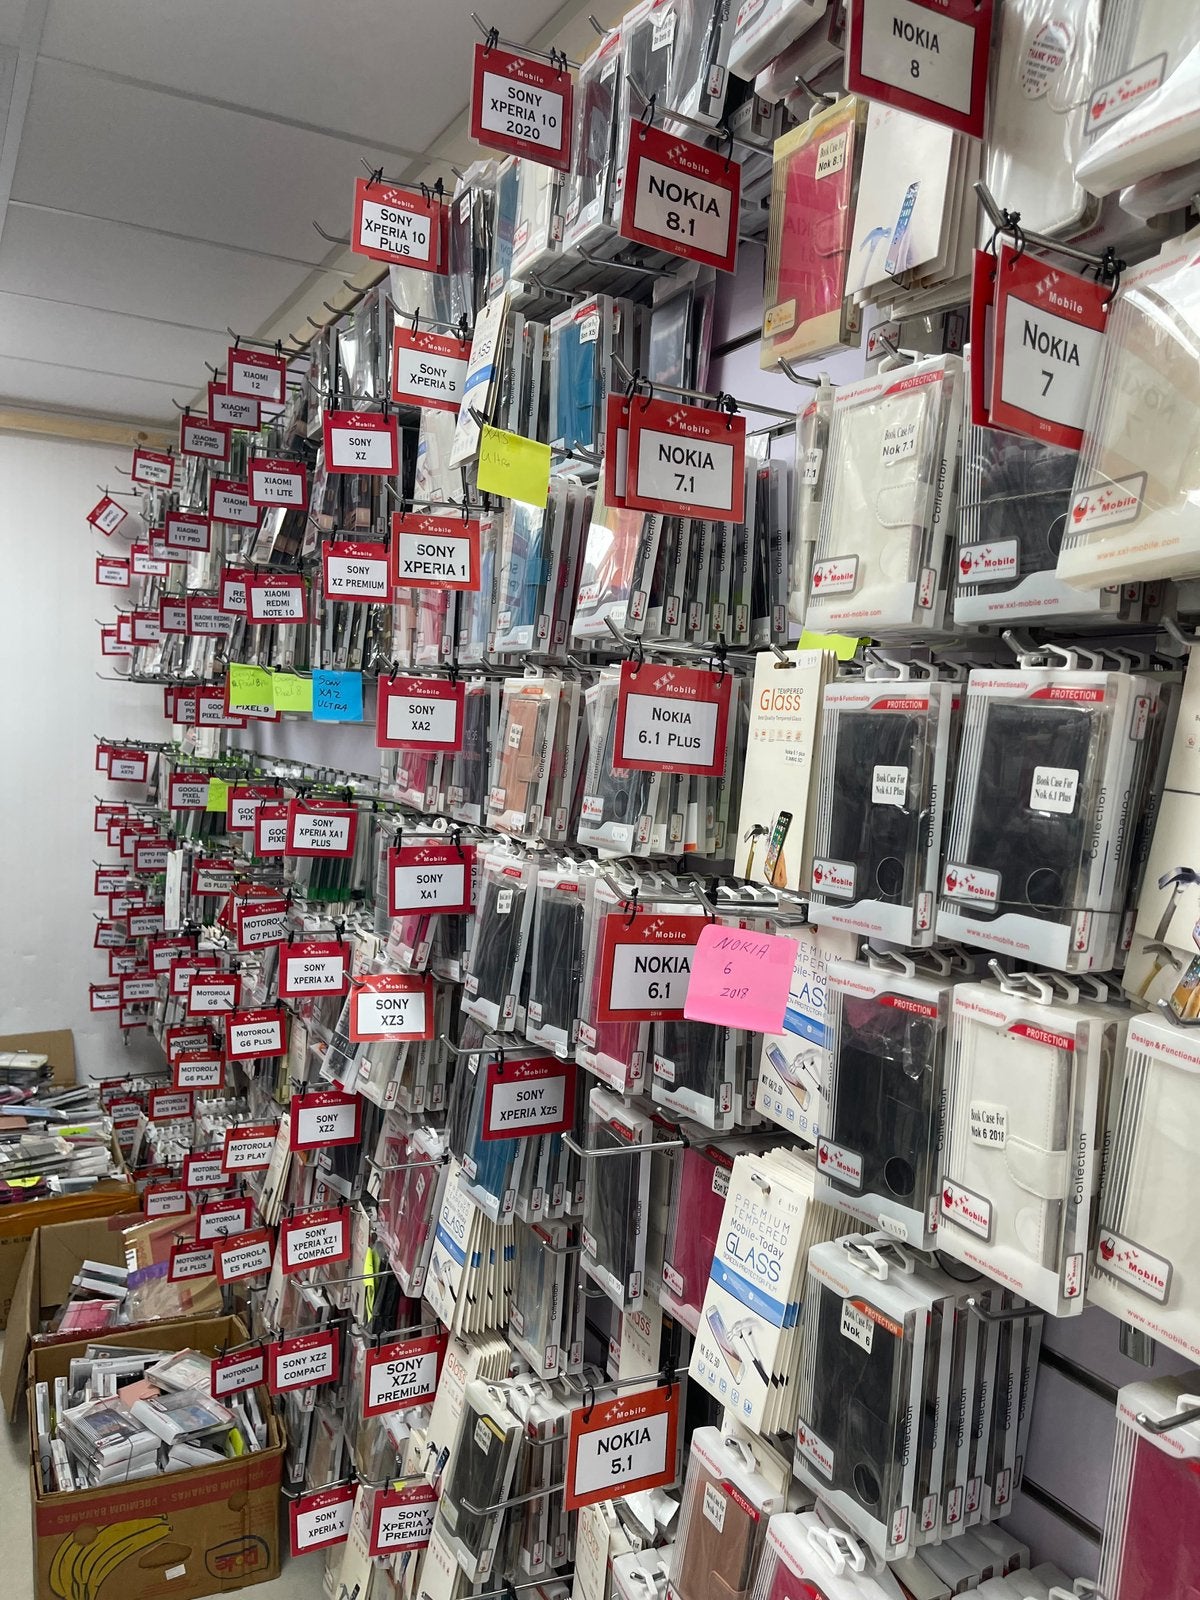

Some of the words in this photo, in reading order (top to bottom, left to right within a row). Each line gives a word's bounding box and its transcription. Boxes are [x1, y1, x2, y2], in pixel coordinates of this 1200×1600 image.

[892, 17, 940, 54] NOKIA
[910, 59, 920, 79] 8
[507, 87, 542, 107] SONY
[490, 98, 537, 123] XPERIA
[541, 112, 557, 128] 10
[506, 120, 541, 140] 2020
[648, 175, 721, 218] NOKIA
[380, 208, 413, 227] SONY
[665, 211, 696, 237] 8.1
[364, 218, 407, 240] XPERIA
[412, 231, 426, 244] 10
[379, 238, 410, 256] PLUS
[1023, 318, 1081, 367] NOKIA
[243, 371, 269, 381] XIAOMI
[419, 363, 447, 378] SONY
[409, 373, 446, 390] XPERIA
[448, 380, 456, 391] 5
[900, 373, 937, 390] PROTECTION
[1041, 369, 1055, 397] 7
[221, 402, 250, 413] XIAOMI
[193, 434, 218, 442] XIAOMI
[348, 437, 372, 448] SONY
[355, 451, 367, 460] XZ
[882, 445, 900, 456] Nok
[902, 440, 914, 452] 7.1
[658, 443, 715, 471] NOKIA
[264, 477, 292, 486] XIAOMI
[674, 473, 695, 493] 7.1
[277, 489, 293, 497] LITE
[931, 458, 948, 524] Collection
[223, 497, 247, 506] XIAOMI
[176, 526, 198, 534] XIAOMI
[187, 535, 200, 543] PRO
[416, 543, 456, 558] SONY
[347, 566, 369, 574] SONY
[404, 560, 455, 576] XPERIA
[461, 565, 466, 577] 1
[332, 578, 343, 586] XZ
[346, 579, 384, 589] PREMIUM
[760, 689, 801, 711] Glass
[1050, 689, 1097, 701] PROTECTION
[318, 700, 348, 711] ULTRA
[408, 704, 435, 715] SONY
[887, 700, 923, 710] PROTECTION
[651, 707, 692, 724] NOKIA
[411, 721, 431, 731] XA2
[639, 731, 661, 745] 6.1
[667, 733, 701, 749] PLUS
[1036, 775, 1049, 787] Book
[1050, 776, 1062, 788] Case
[1063, 779, 1073, 789] For
[312, 819, 334, 827] SONY
[925, 783, 938, 848] Collection
[1089, 786, 1107, 860] Collection
[299, 828, 326, 837] XPERIA
[329, 829, 343, 838] XA1
[311, 838, 331, 847] PLUS
[416, 874, 443, 884] SONY
[420, 890, 437, 899] XA1
[243, 917, 288, 930] MOTOROLA
[250, 932, 261, 941] G7
[262, 930, 283, 938] PLUS
[713, 936, 770, 959] NOKIA
[304, 963, 326, 971] SONY
[634, 955, 691, 975] NOKIA
[723, 961, 732, 975] 6
[294, 976, 322, 985] XPERIA
[648, 982, 671, 999] 6.1
[720, 987, 749, 999] 2018
[376, 999, 409, 1011] SONY
[893, 998, 933, 1016] PROTECTION
[381, 1015, 404, 1026] XZ3
[236, 1028, 275, 1037] MOTOROLA
[1025, 1026, 1070, 1049] PROTECTION
[1131, 1032, 1156, 1049] Design
[181, 1065, 218, 1073] MOTOROLA
[516, 1089, 545, 1102] SONY
[316, 1113, 339, 1124] SONY
[500, 1108, 537, 1121] XPERIA
[936, 1087, 948, 1152] Collection
[970, 1109, 981, 1124] Book
[981, 1110, 995, 1125] Case
[996, 1111, 1005, 1126] For
[319, 1124, 335, 1134] XZ2
[230, 1141, 272, 1151] MOTOROLA
[247, 1152, 266, 1160] PLAY
[1073, 1132, 1087, 1206] Collection
[150, 1194, 184, 1203] MOTOROLA
[205, 1214, 241, 1225] MOTOROLA
[734, 1193, 792, 1234] PREMIUM
[733, 1204, 788, 1246] TEMPERED
[305, 1228, 327, 1239] SONY
[730, 1216, 785, 1260] Mobile-Today
[293, 1240, 322, 1252] XPERIA
[323, 1237, 337, 1246] XZ1
[176, 1254, 212, 1265] MOTOROLA
[223, 1248, 267, 1265] MOTOROLA
[298, 1246, 335, 1261] COMPACT
[724, 1230, 782, 1284] GLASS
[179, 1265, 188, 1273] E4
[190, 1262, 207, 1270] PLUS
[230, 1265, 241, 1273] E5
[243, 1259, 263, 1270] PLUS
[865, 1305, 897, 1334] PROTECTION
[843, 1320, 860, 1338] Nok
[866, 1336, 870, 1346] 6
[283, 1357, 307, 1369] SONY
[310, 1352, 327, 1363] XZ2
[386, 1357, 424, 1375] SONY
[222, 1364, 259, 1380] MOTOROLA
[284, 1364, 326, 1380] COMPACT
[391, 1372, 417, 1387] XZ2
[377, 1383, 430, 1404] PREMIUM
[957, 1387, 967, 1448] Collection
[975, 1379, 988, 1441] Collection
[597, 1427, 652, 1456] NOKIA
[900, 1404, 913, 1467] Collection
[610, 1455, 633, 1475] 5.1
[731, 1489, 757, 1519] PROTECTION
[315, 1510, 337, 1523] SONY
[398, 1509, 429, 1520] SONY
[308, 1524, 337, 1538] XPERIA
[339, 1520, 345, 1529] X
